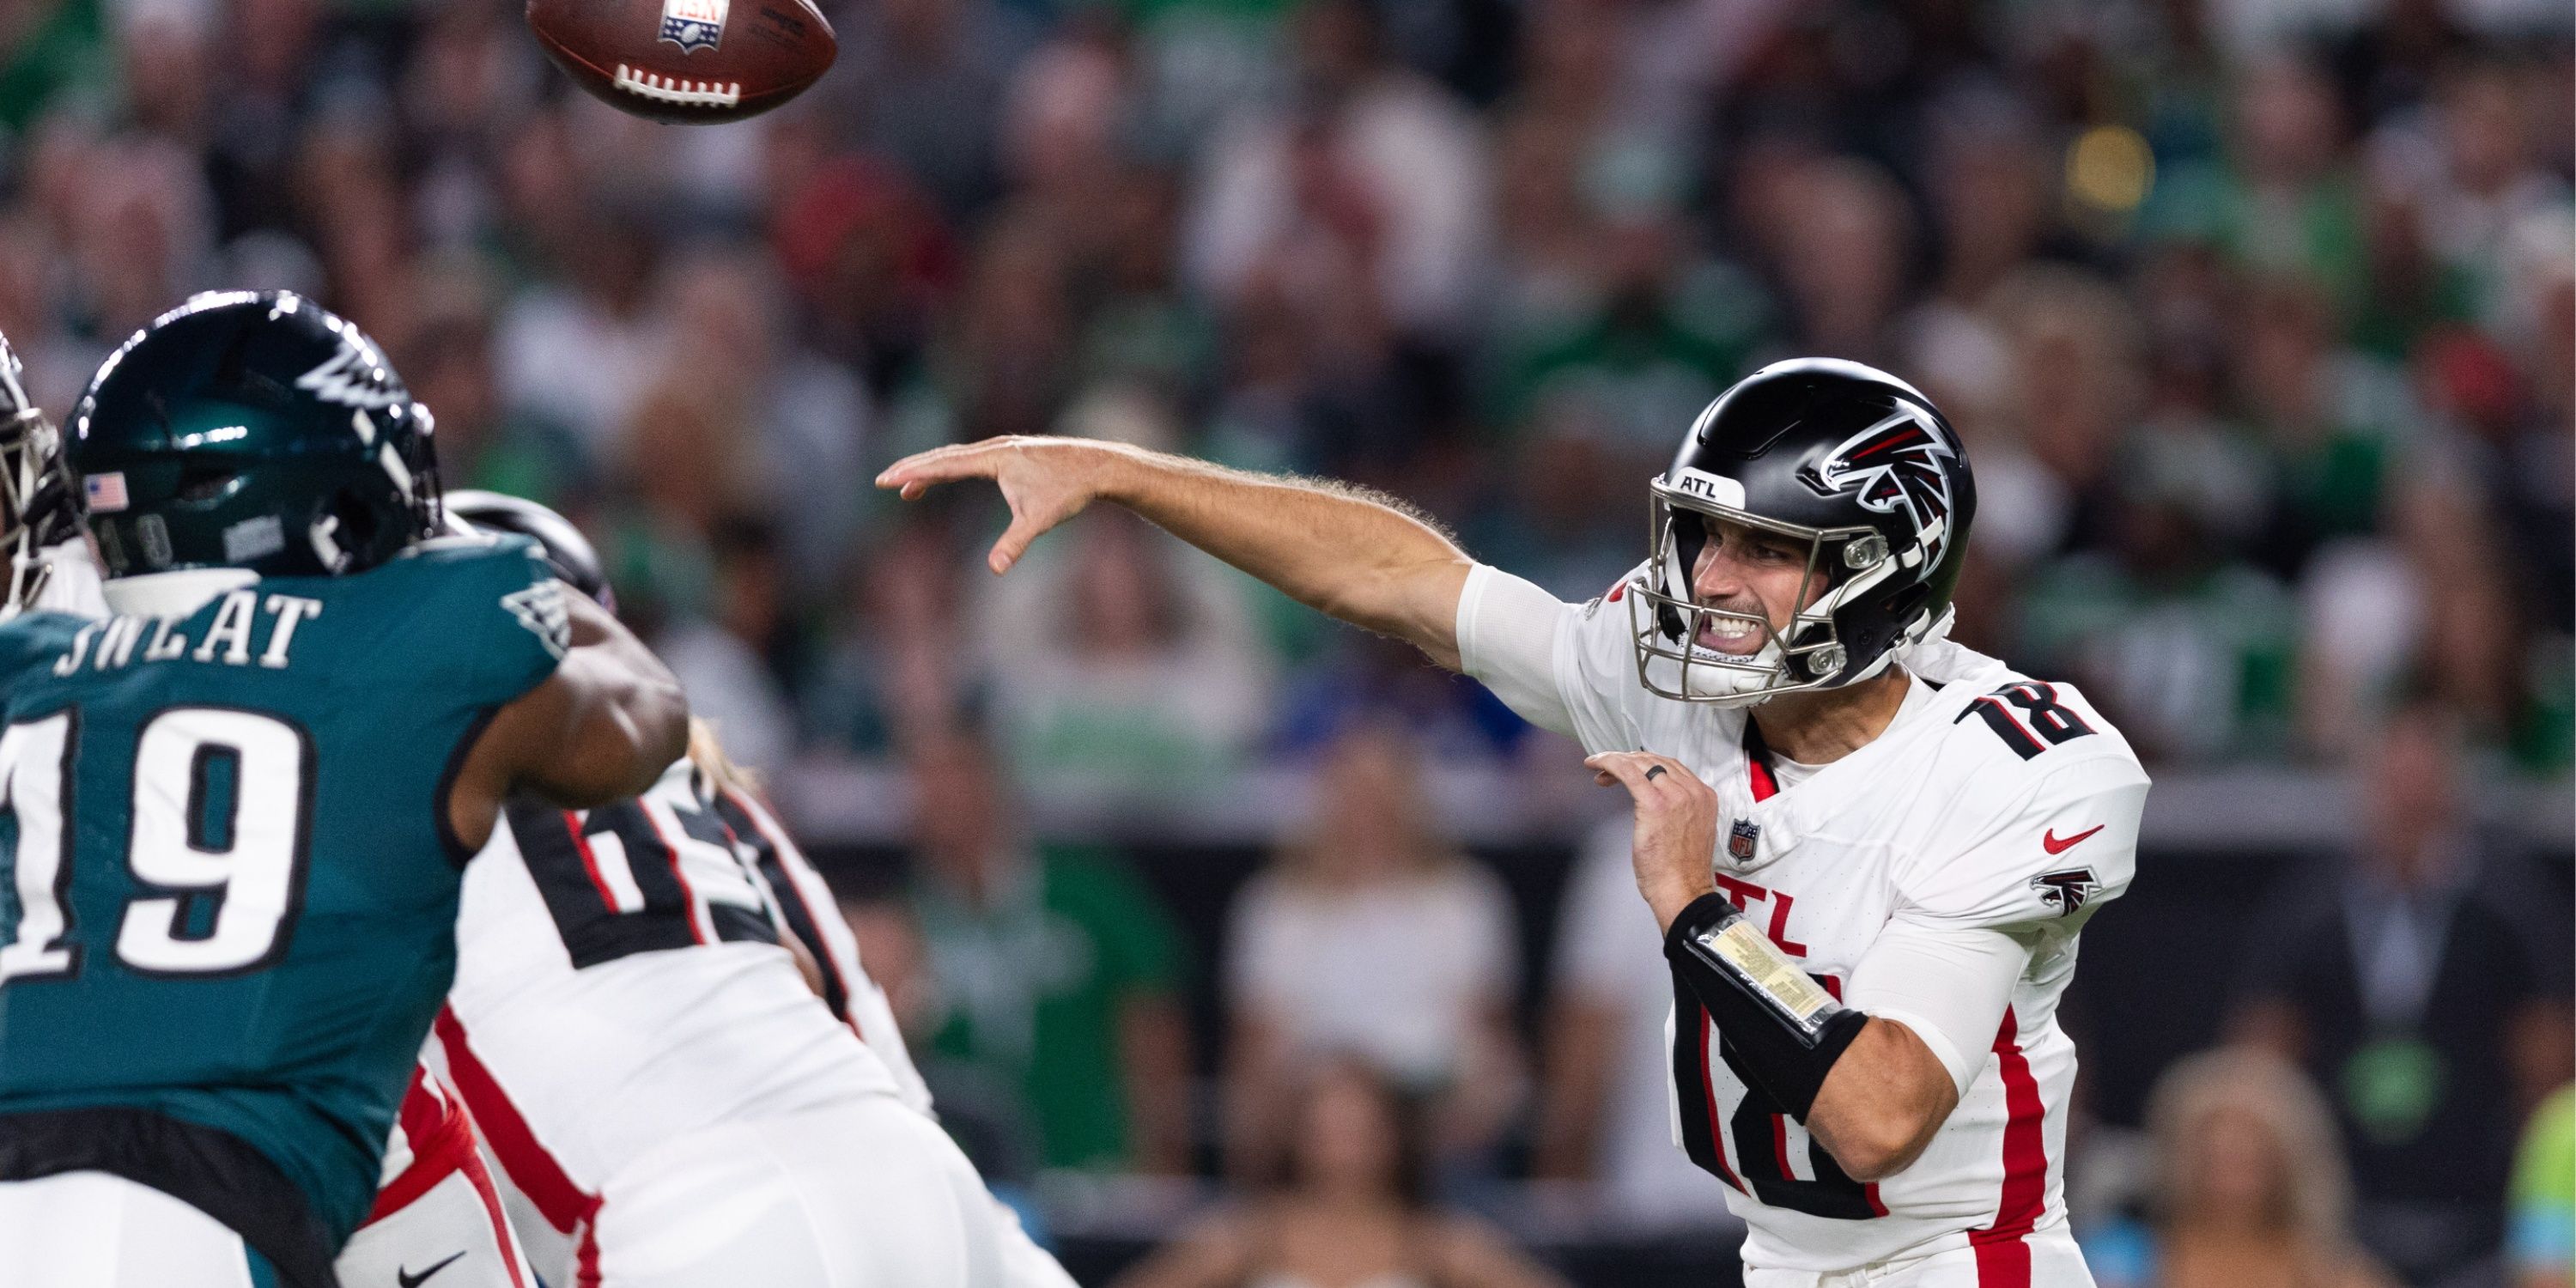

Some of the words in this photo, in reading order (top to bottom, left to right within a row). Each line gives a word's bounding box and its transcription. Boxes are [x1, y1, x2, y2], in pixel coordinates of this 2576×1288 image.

[1680, 476, 1716, 499] ATL
[1953, 681, 2099, 761] 18
[0, 706, 318, 982] 19
[1731, 834, 1753, 856] NFL
[1715, 872, 1807, 958] TL
